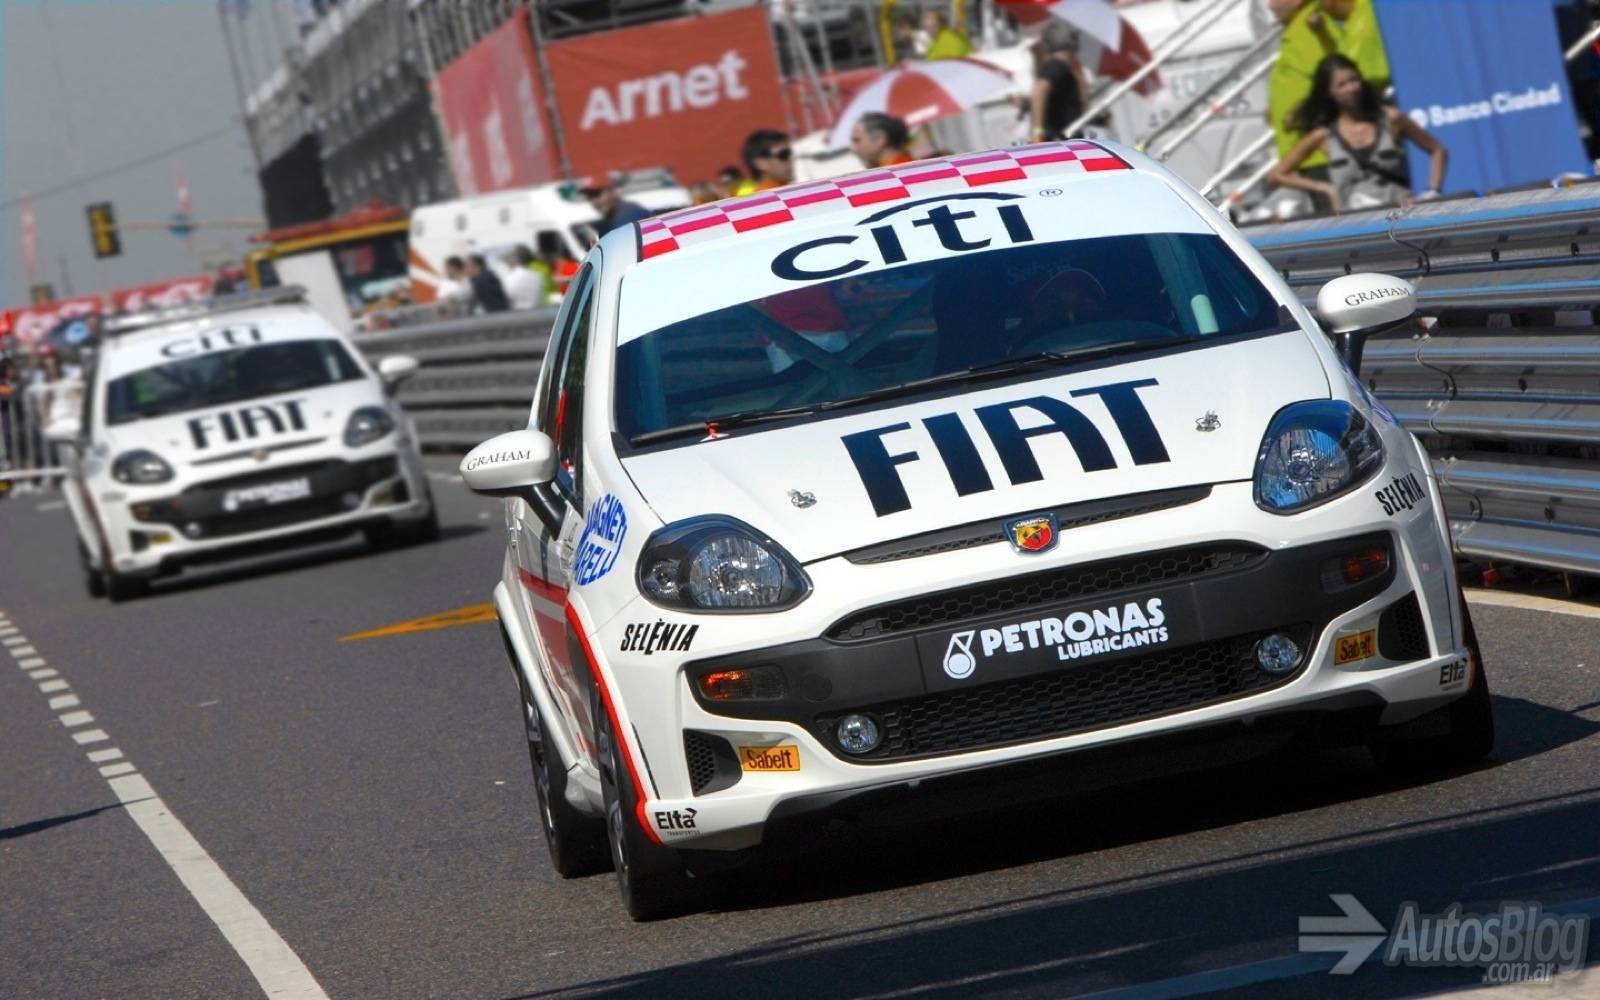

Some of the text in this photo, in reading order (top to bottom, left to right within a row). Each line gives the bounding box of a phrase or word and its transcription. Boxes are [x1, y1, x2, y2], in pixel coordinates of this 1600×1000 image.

[580, 49, 749, 130] Arnet
[1429, 82, 1562, 128] Banco Ciudad
[770, 192, 1036, 281] citi
[1344, 284, 1411, 307] GRAHAM
[188, 400, 308, 449] FIAT
[840, 377, 1171, 518] FIAT
[466, 449, 532, 471] GRAHAM
[980, 597, 1166, 657] PETRONAS
[1057, 626, 1169, 661] LUBRICANTS
[746, 748, 794, 771] Sabelt
